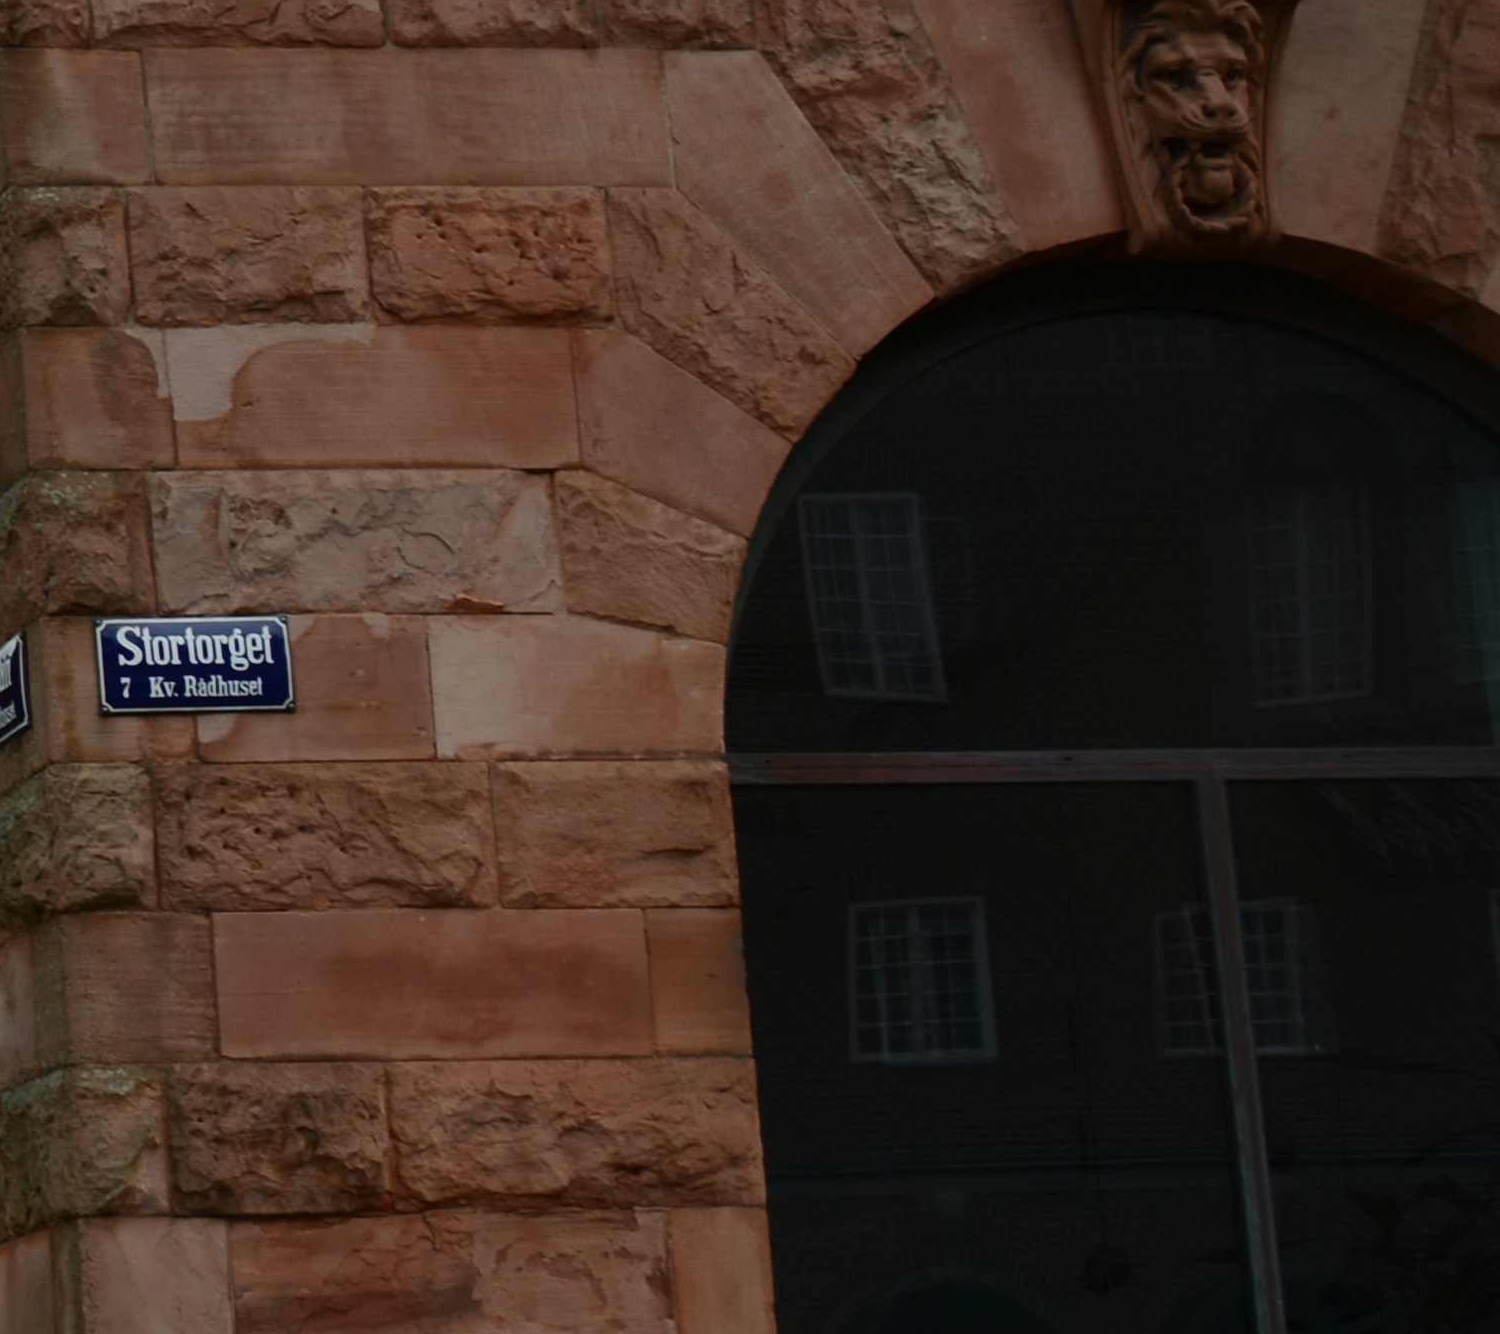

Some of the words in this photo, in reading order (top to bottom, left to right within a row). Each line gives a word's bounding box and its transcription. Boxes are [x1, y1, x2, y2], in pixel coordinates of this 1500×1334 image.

[116, 625, 275, 672] Stortorget
[120, 677, 132, 699] 7
[149, 676, 179, 699] Kv.
[184, 675, 263, 698] Rådhuset
